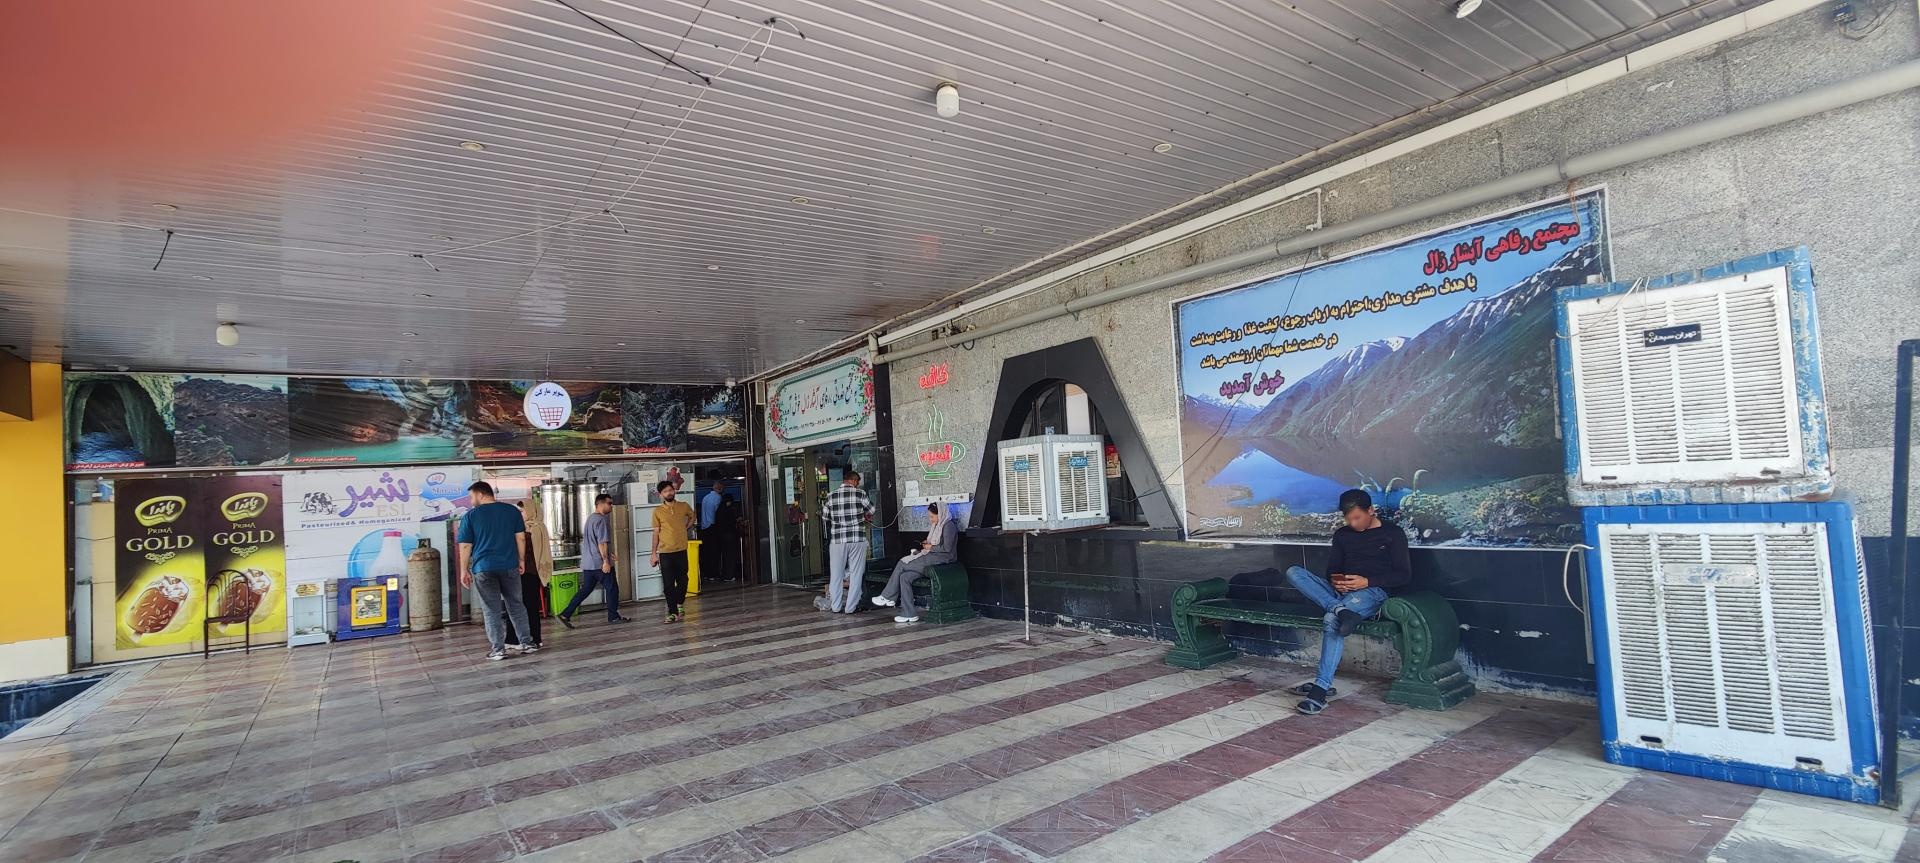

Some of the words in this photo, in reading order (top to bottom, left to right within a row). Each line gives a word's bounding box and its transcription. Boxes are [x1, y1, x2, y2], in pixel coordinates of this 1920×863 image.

[1485, 228, 1531, 262] رفاهی
[1531, 222, 1580, 251] مجتمع
[1423, 249, 1448, 276] زال
[1447, 236, 1484, 271] آبشار
[1438, 277, 1466, 295] هدف
[1465, 272, 1477, 292] با
[1402, 283, 1437, 306] مشتری
[1306, 304, 1330, 326] ارباب
[1330, 305, 1341, 320] به
[1243, 321, 1258, 336] غذا
[1257, 316, 1280, 334] کیفیت
[1190, 332, 1216, 347] بهداشت
[1215, 327, 1236, 343] رعایت
[1236, 329, 1243, 341] و
[1300, 333, 1326, 350] خدمت
[1326, 333, 1338, 350] در
[1675, 331, 1697, 340] تهران
[1256, 343, 1284, 361] مهمانان
[1283, 338, 1300, 353] شما
[1228, 346, 1256, 364] ارزشمند
[919, 363, 949, 388] کافه
[1253, 369, 1285, 396] خوش
[1219, 372, 1252, 399] آمدید
[339, 472, 409, 517] شیر
[150, 501, 175, 515] پاندا
[234, 497, 259, 511] پاندا
[126, 535, 194, 552] GOLD
[213, 530, 275, 546] GOLD
